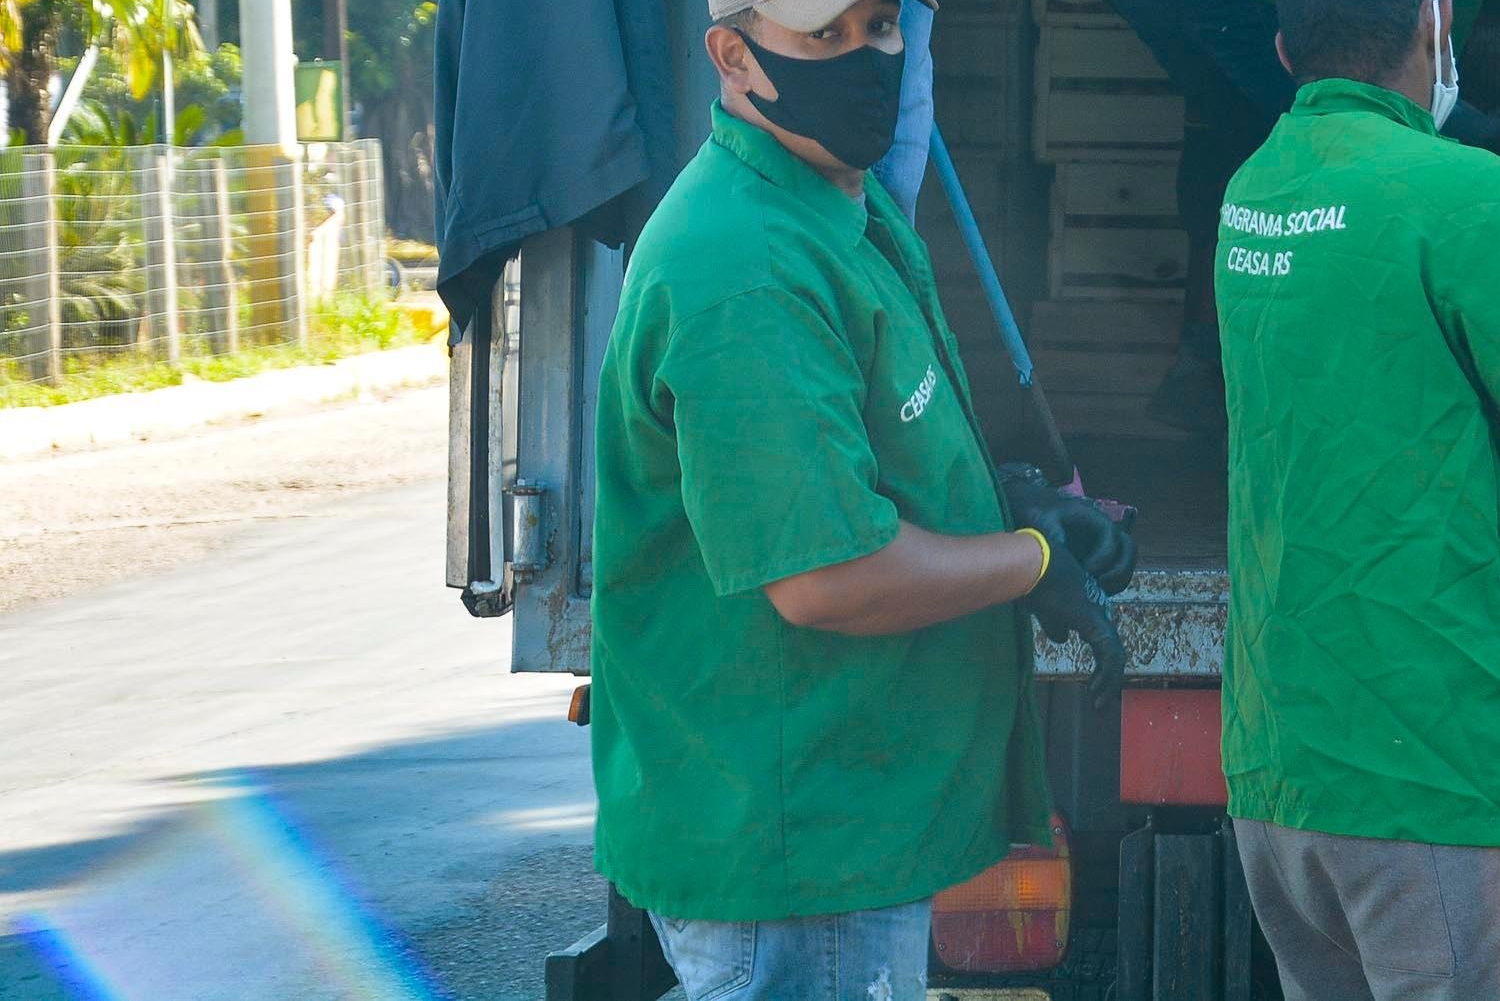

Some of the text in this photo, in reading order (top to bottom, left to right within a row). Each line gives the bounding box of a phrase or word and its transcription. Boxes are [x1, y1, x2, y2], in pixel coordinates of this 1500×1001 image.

[1284, 204, 1346, 236] SOCIAL
[1227, 245, 1293, 276] CEASA RS
